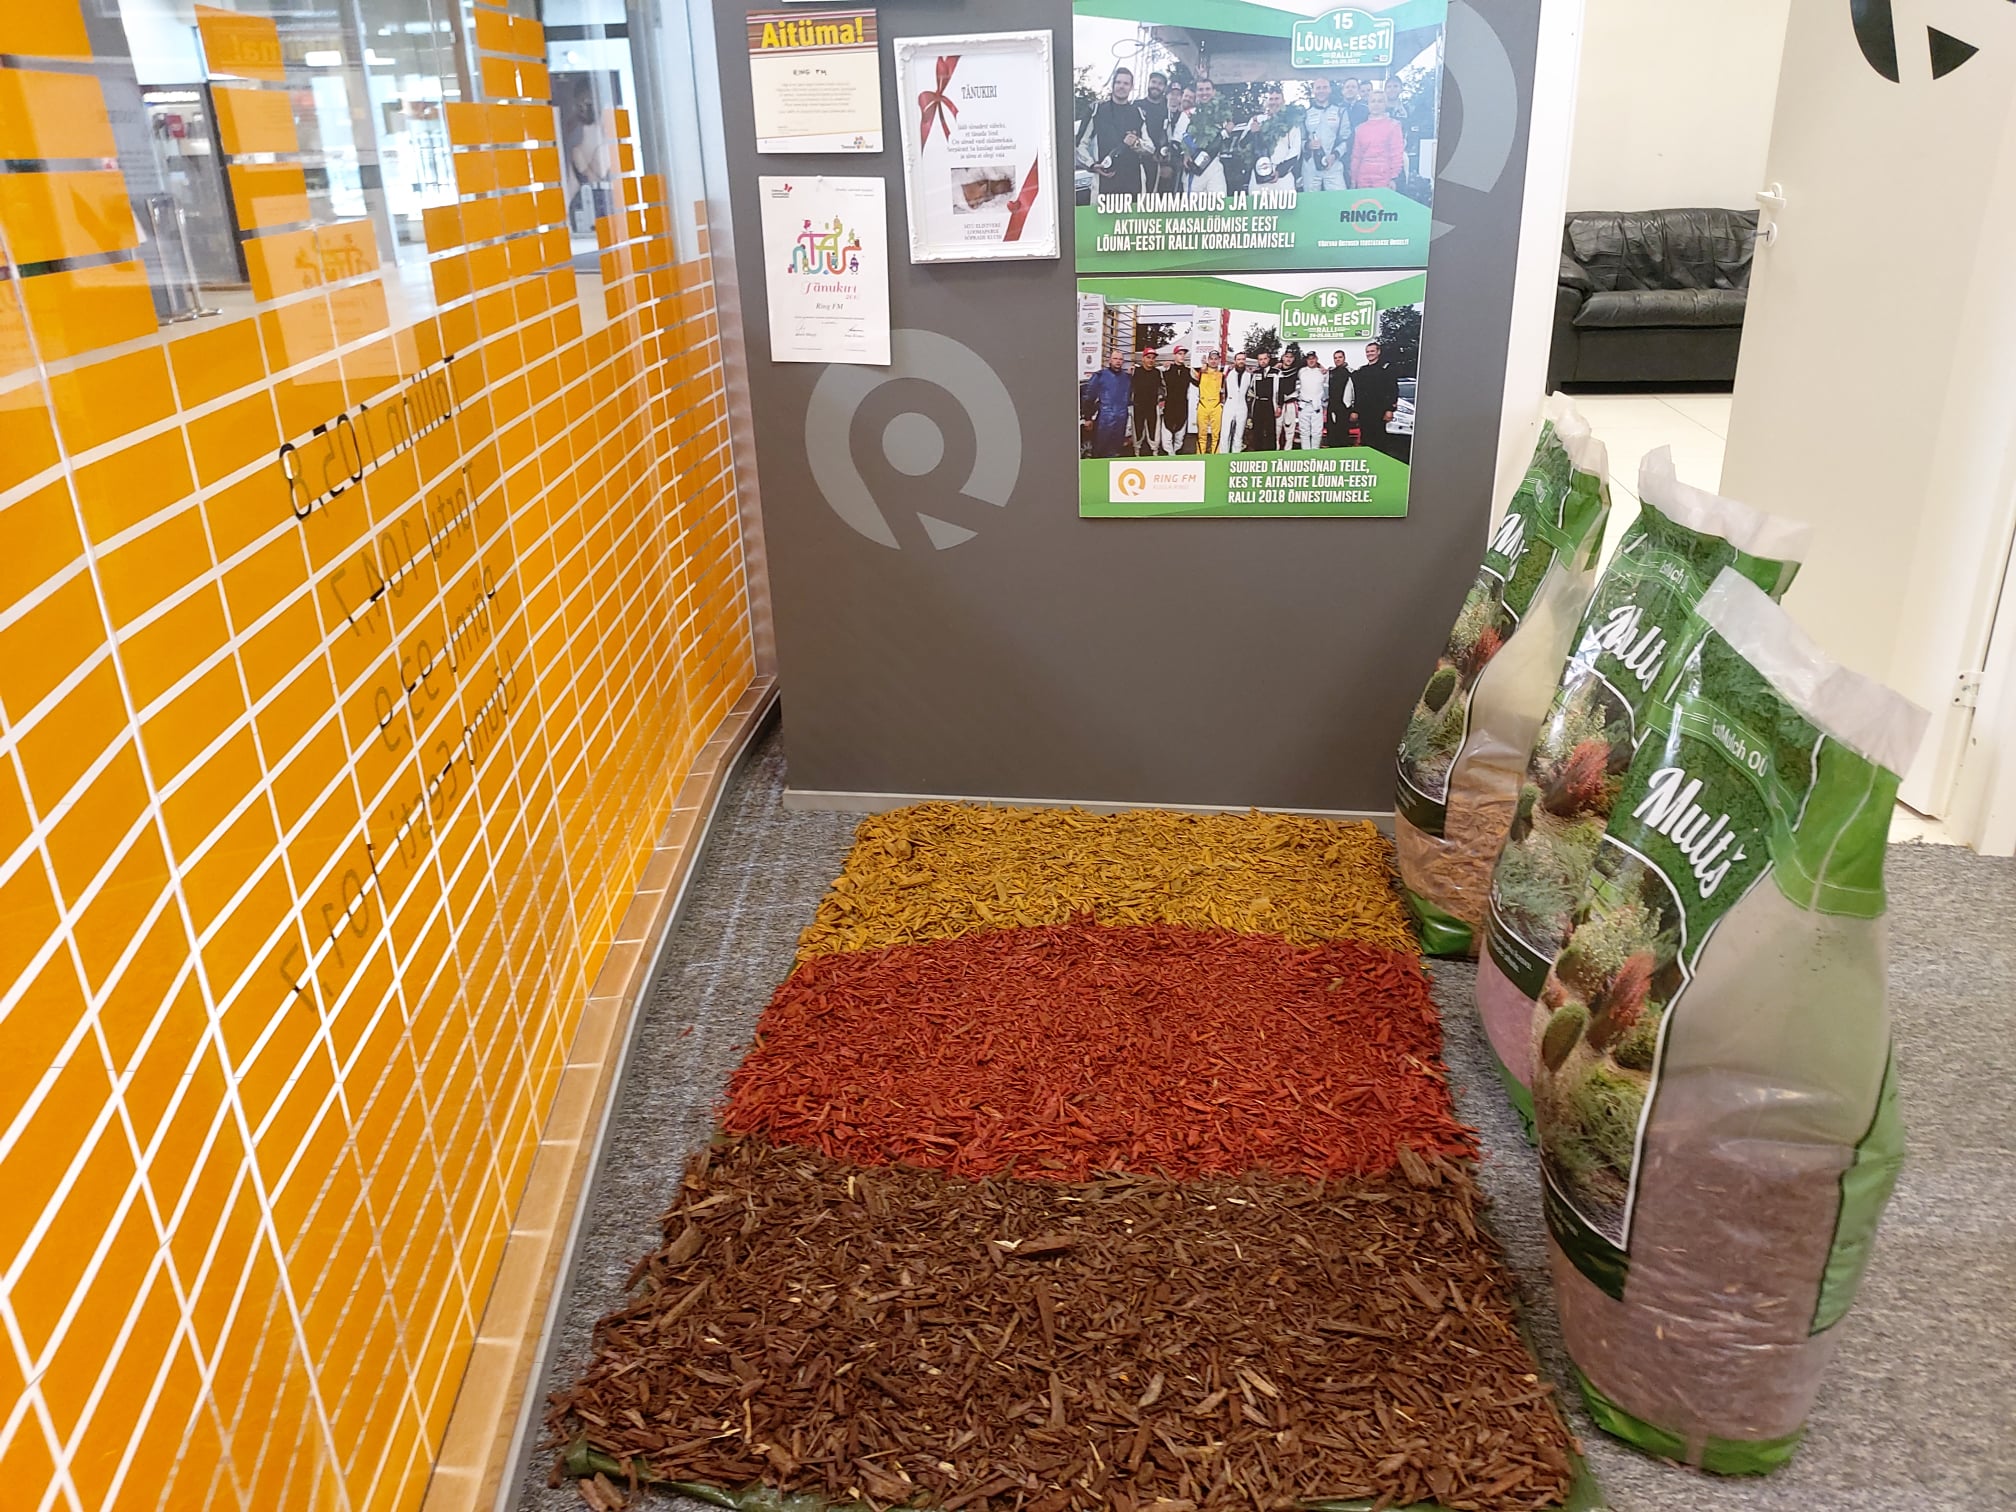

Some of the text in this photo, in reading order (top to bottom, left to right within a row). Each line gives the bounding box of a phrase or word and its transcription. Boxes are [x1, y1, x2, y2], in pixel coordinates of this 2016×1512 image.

[1332, 12, 1354, 30] 15
[761, 16, 865, 49] Aitüma!
[1296, 28, 1390, 52] LÕUNA-EESTI
[961, 84, 998, 100] TÄNUKIRI
[1097, 187, 1298, 214] SUUR KUMMARDUS JA TÄNUD
[1113, 214, 1279, 235] AKTIIVSE KAASALÖÖMISE EEST
[1096, 231, 1296, 252] LÕUNA-EESTI RALLI KORRALDAMISEL!
[1318, 291, 1339, 309] 16
[1284, 306, 1372, 327] LÕUNA-EESTI
[1229, 458, 1370, 474] SUURED TÄNUDSÕNAD TEILE,
[1153, 473, 1198, 484] RING FM
[1228, 473, 1378, 489] KES TE AITASITE LÕUNA-EESTI
[1228, 488, 1373, 504] RALLI 2018 ÕNNESTUMISELE.
